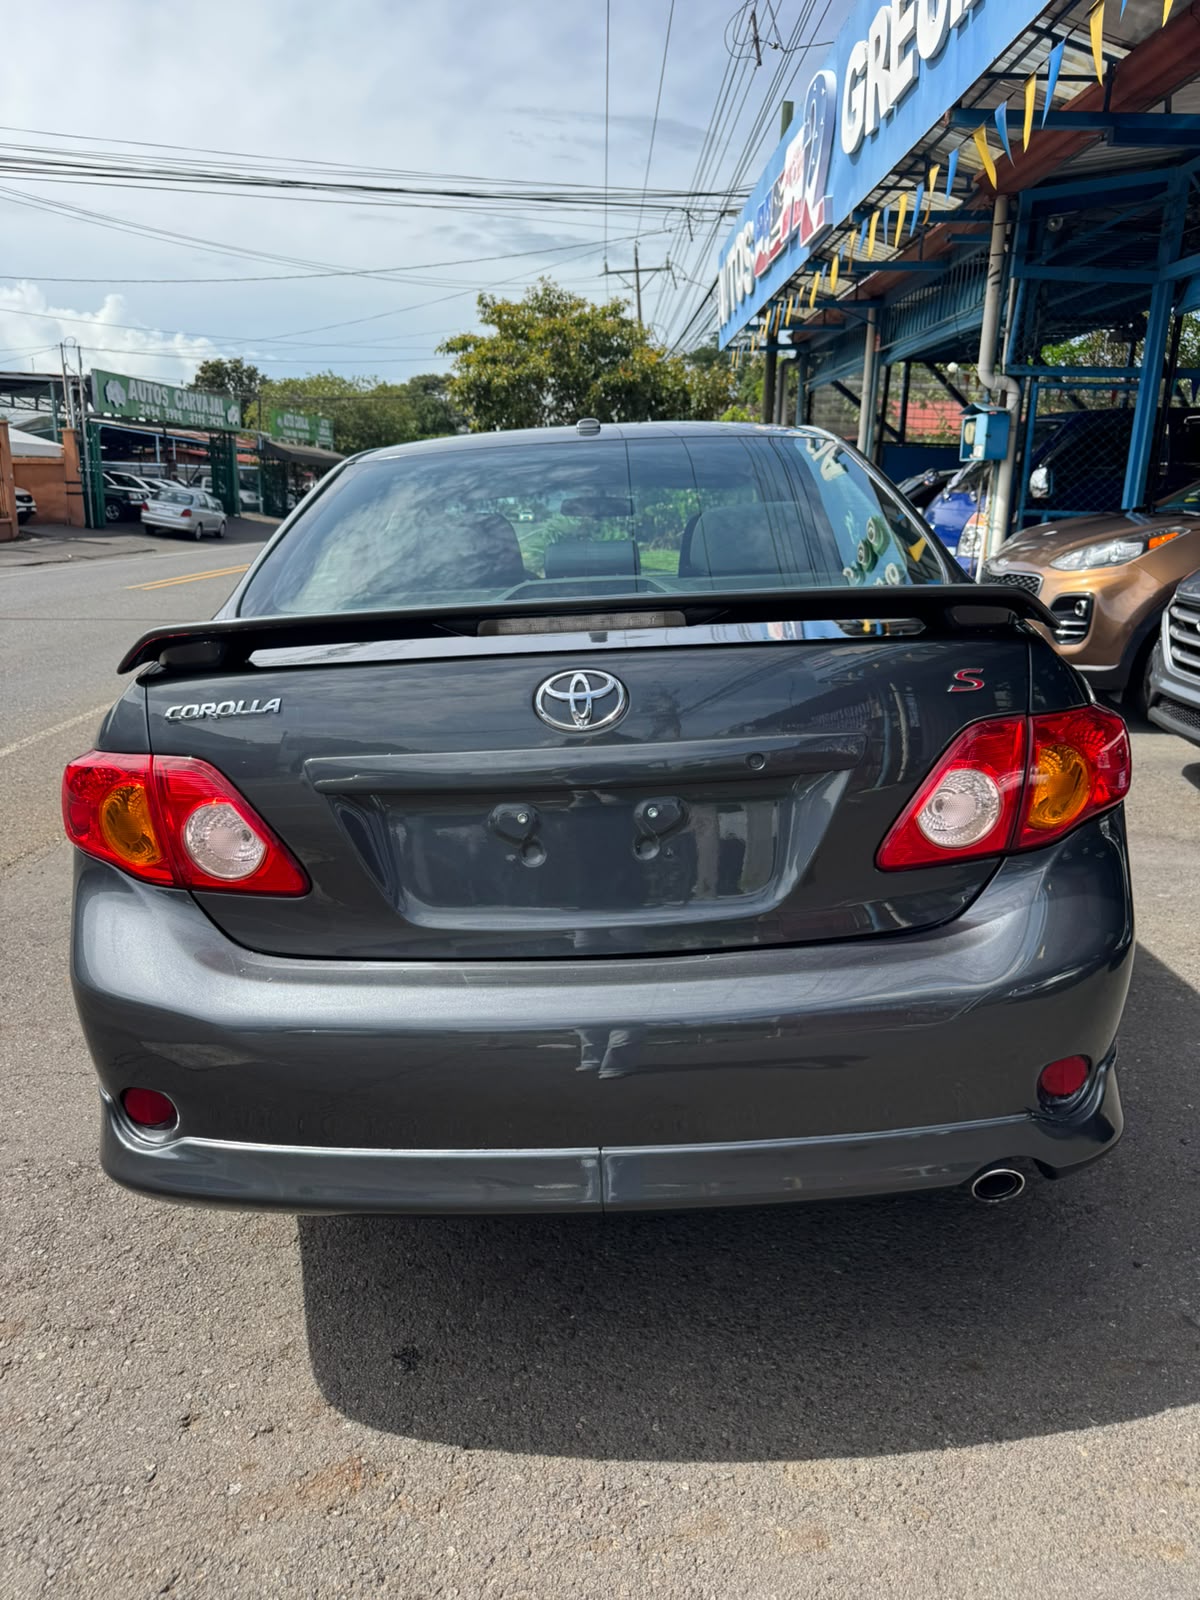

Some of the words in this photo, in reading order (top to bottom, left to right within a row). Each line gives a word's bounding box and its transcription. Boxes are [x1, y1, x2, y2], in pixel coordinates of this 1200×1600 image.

[127, 380, 169, 407] AUTOS
[174, 390, 226, 417] CARVAJAL
[947, 667, 986, 694] S
[164, 697, 282, 722] COROLLA
